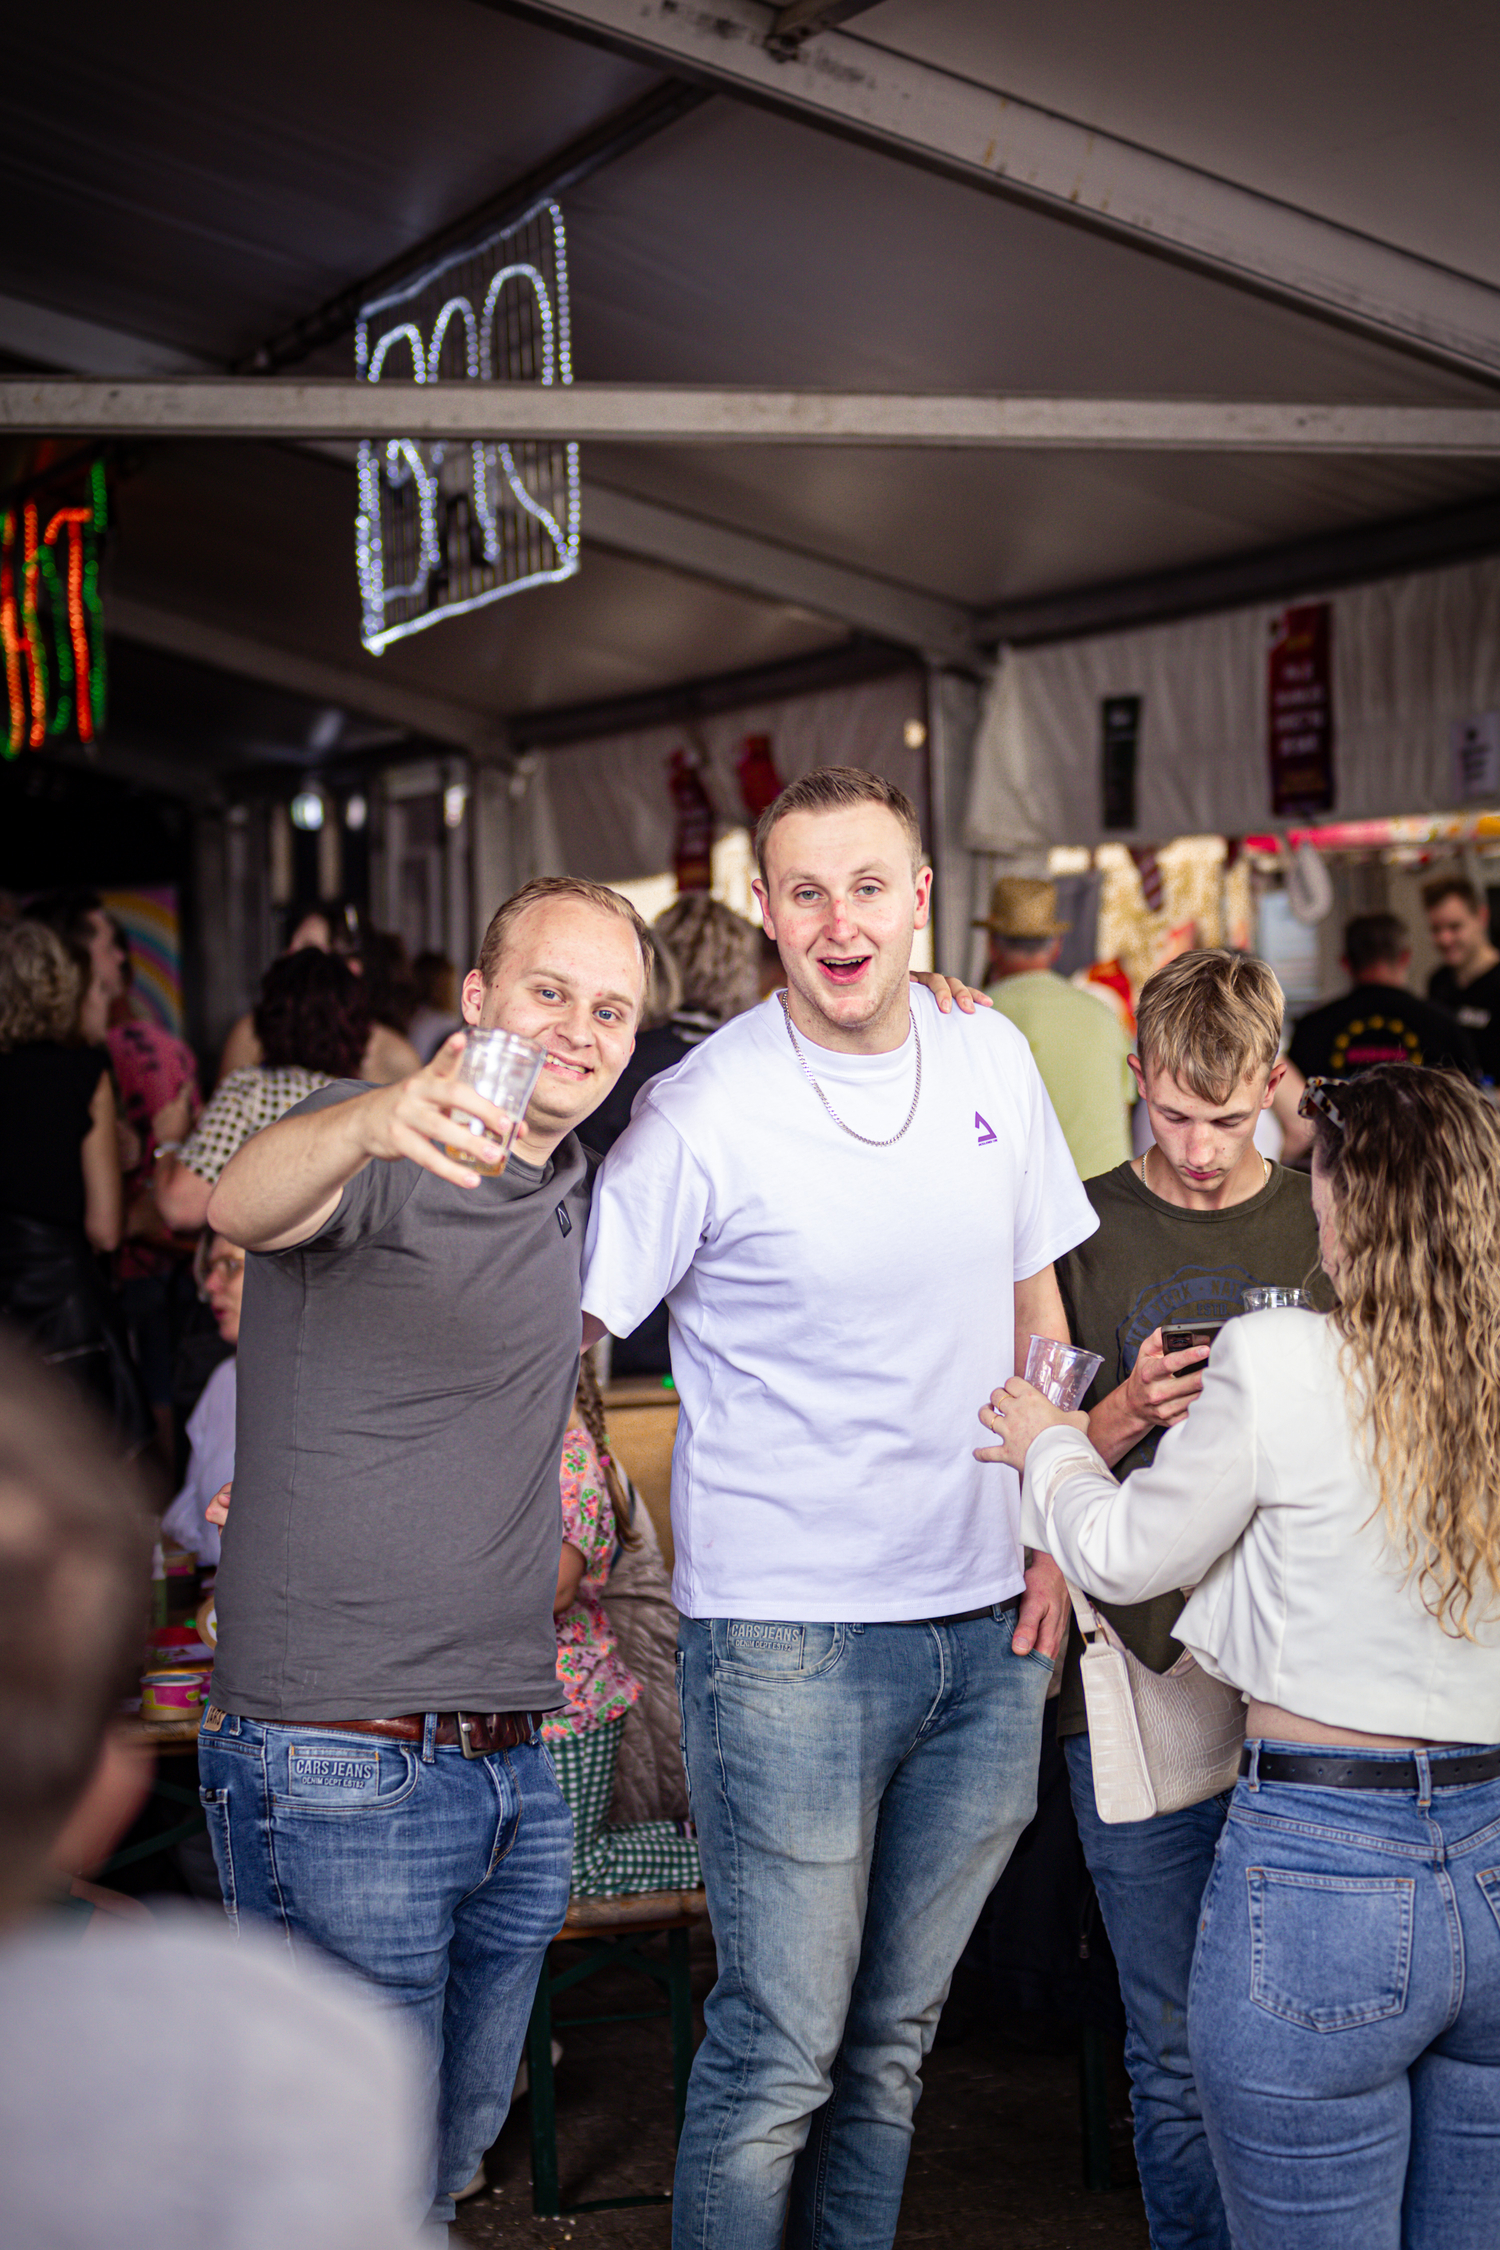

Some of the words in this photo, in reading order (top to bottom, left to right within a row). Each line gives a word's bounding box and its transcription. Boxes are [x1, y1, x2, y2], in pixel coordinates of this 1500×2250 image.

[1129, 1314, 1154, 1349] NEW
[1151, 1282, 1193, 1316] YORK
[731, 1624, 760, 1637] CARS
[763, 1626, 799, 1642] JEANS
[735, 1639, 755, 1647] DENIM
[755, 1640, 772, 1649] DEPT
[296, 1759, 330, 1775] CARS
[331, 1761, 371, 1779] JEANS
[302, 1776, 323, 1785] DENIM
[323, 1777, 343, 1787] DEPT
